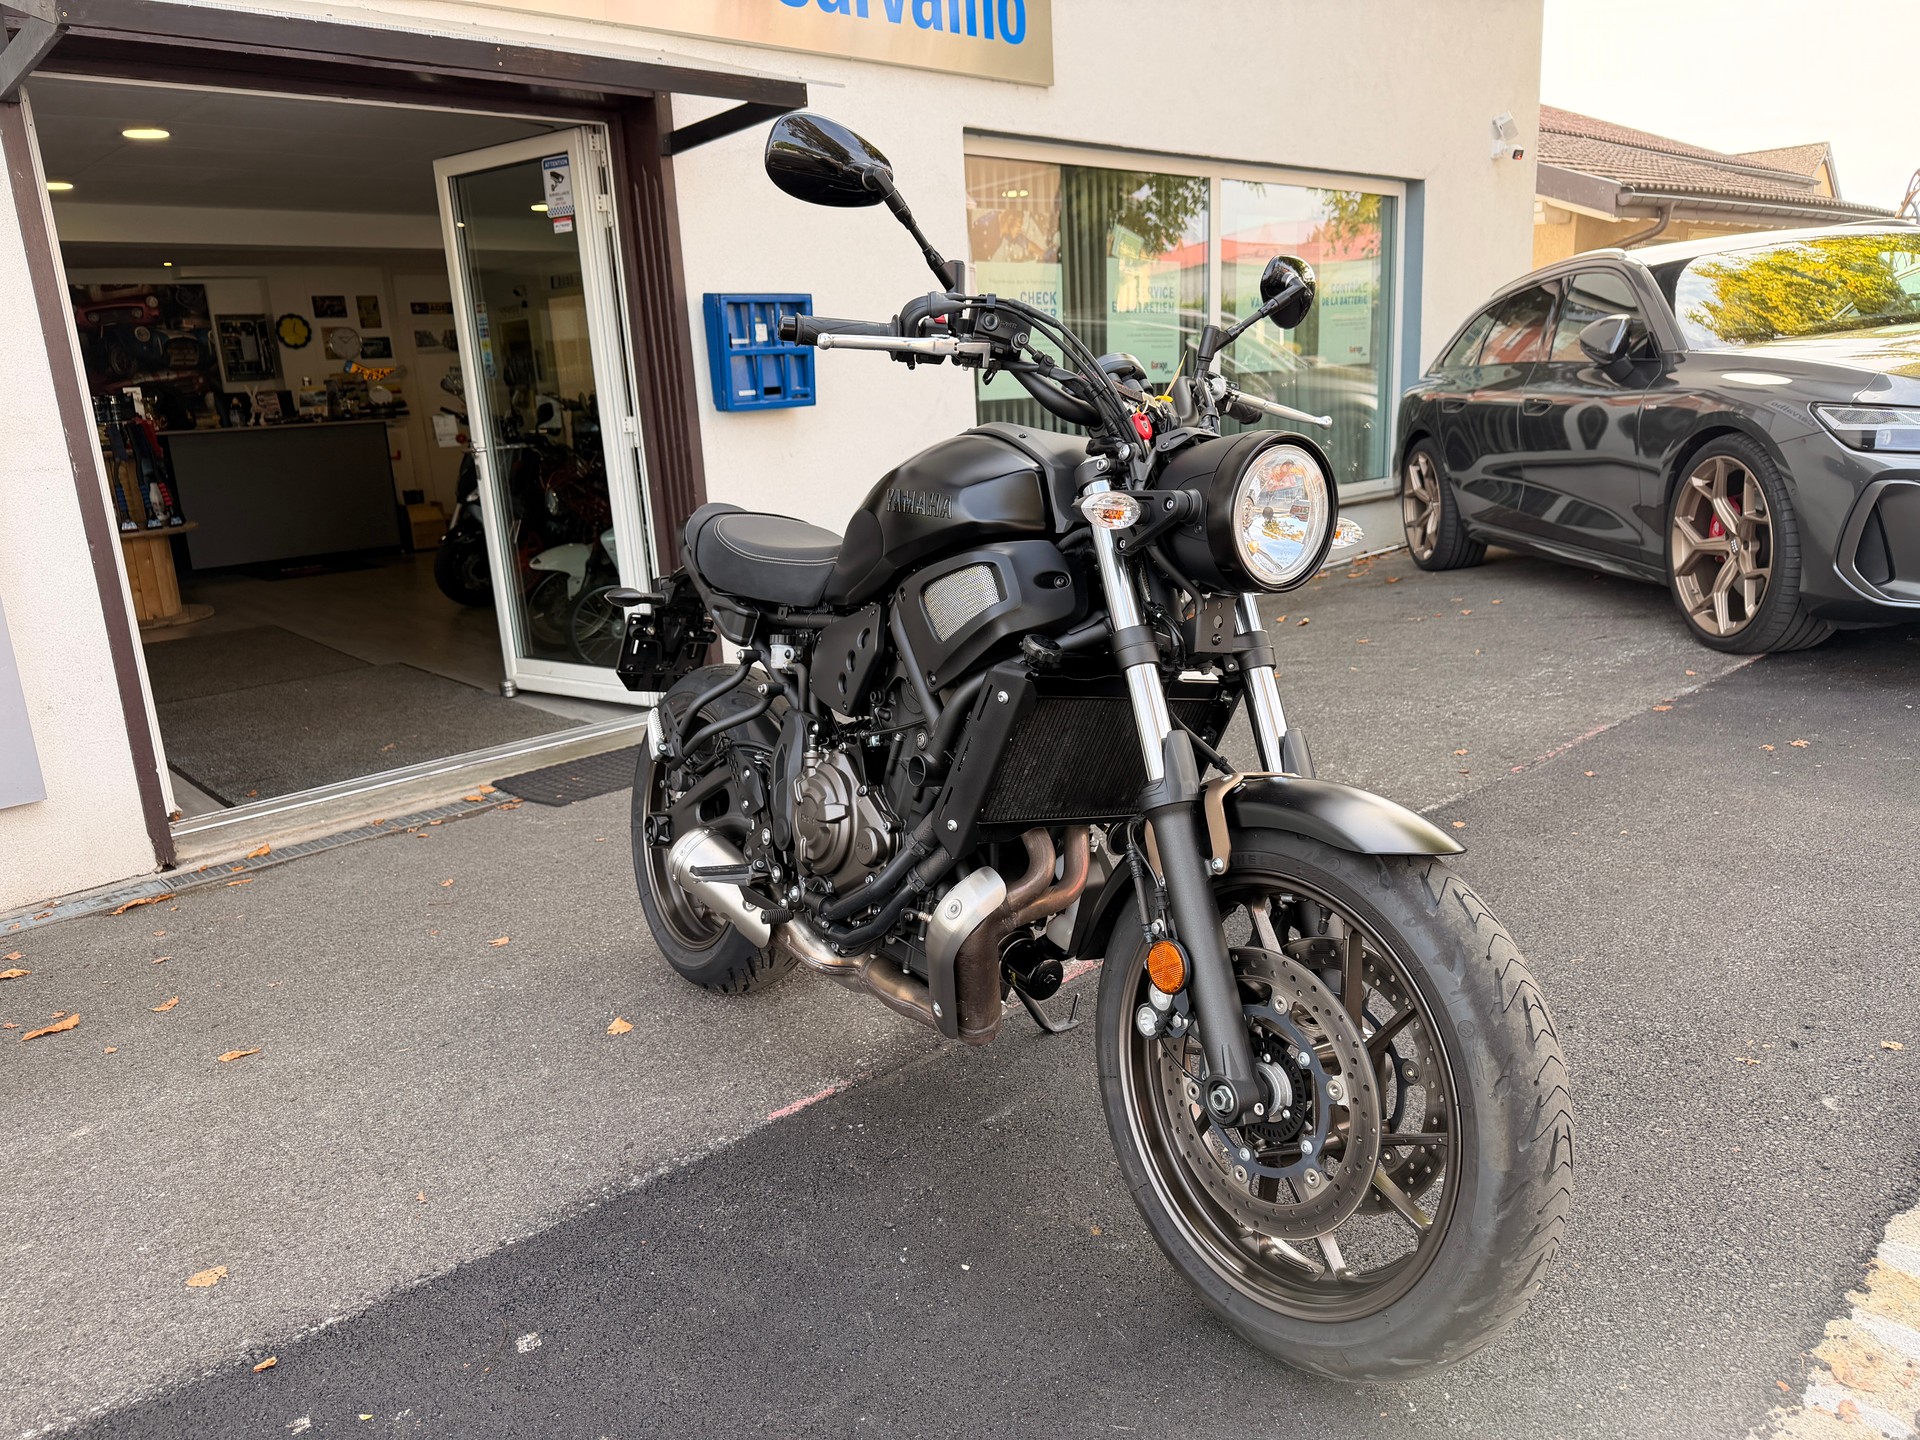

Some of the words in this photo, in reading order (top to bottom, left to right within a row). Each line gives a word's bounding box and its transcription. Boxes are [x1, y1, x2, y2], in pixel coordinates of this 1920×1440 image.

[779, 0, 1027, 45] valho
[1020, 291, 1057, 305] CHECK
[886, 488, 953, 519] YAMAHA
